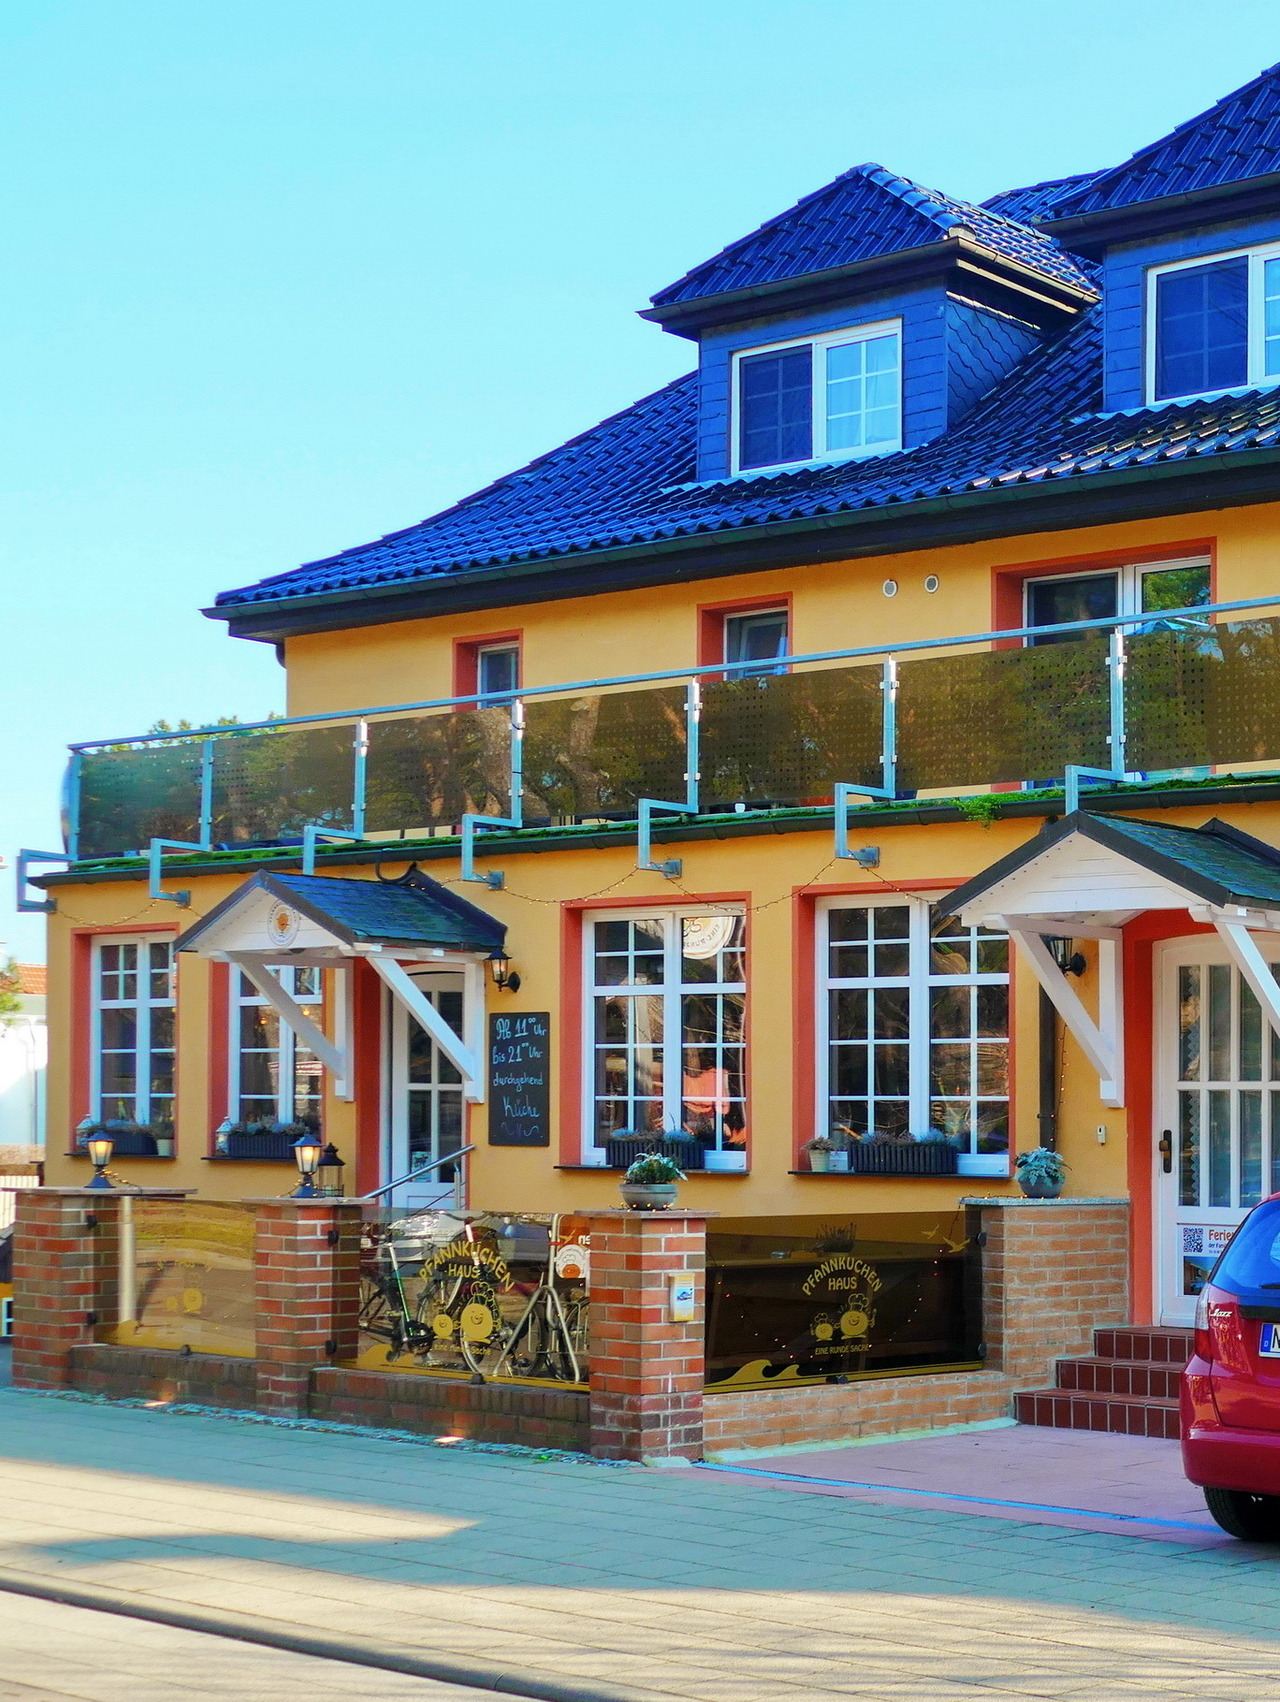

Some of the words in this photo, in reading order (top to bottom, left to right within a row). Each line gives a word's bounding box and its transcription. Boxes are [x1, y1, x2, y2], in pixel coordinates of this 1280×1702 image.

[496, 1018, 511, 1040] Ab
[533, 1024, 547, 1036] Uhr
[492, 1046, 506, 1065] bis
[529, 1046, 544, 1058] Uhr
[493, 1072, 544, 1092] durchgehend
[503, 1094, 540, 1118] Küche
[1208, 1229, 1235, 1241] Ferie
[418, 1241, 517, 1292] PFANNKUCHEN
[448, 1263, 480, 1279] HAUS
[801, 1257, 883, 1295] PFANNKUCHEN
[828, 1277, 857, 1291] HAUS
